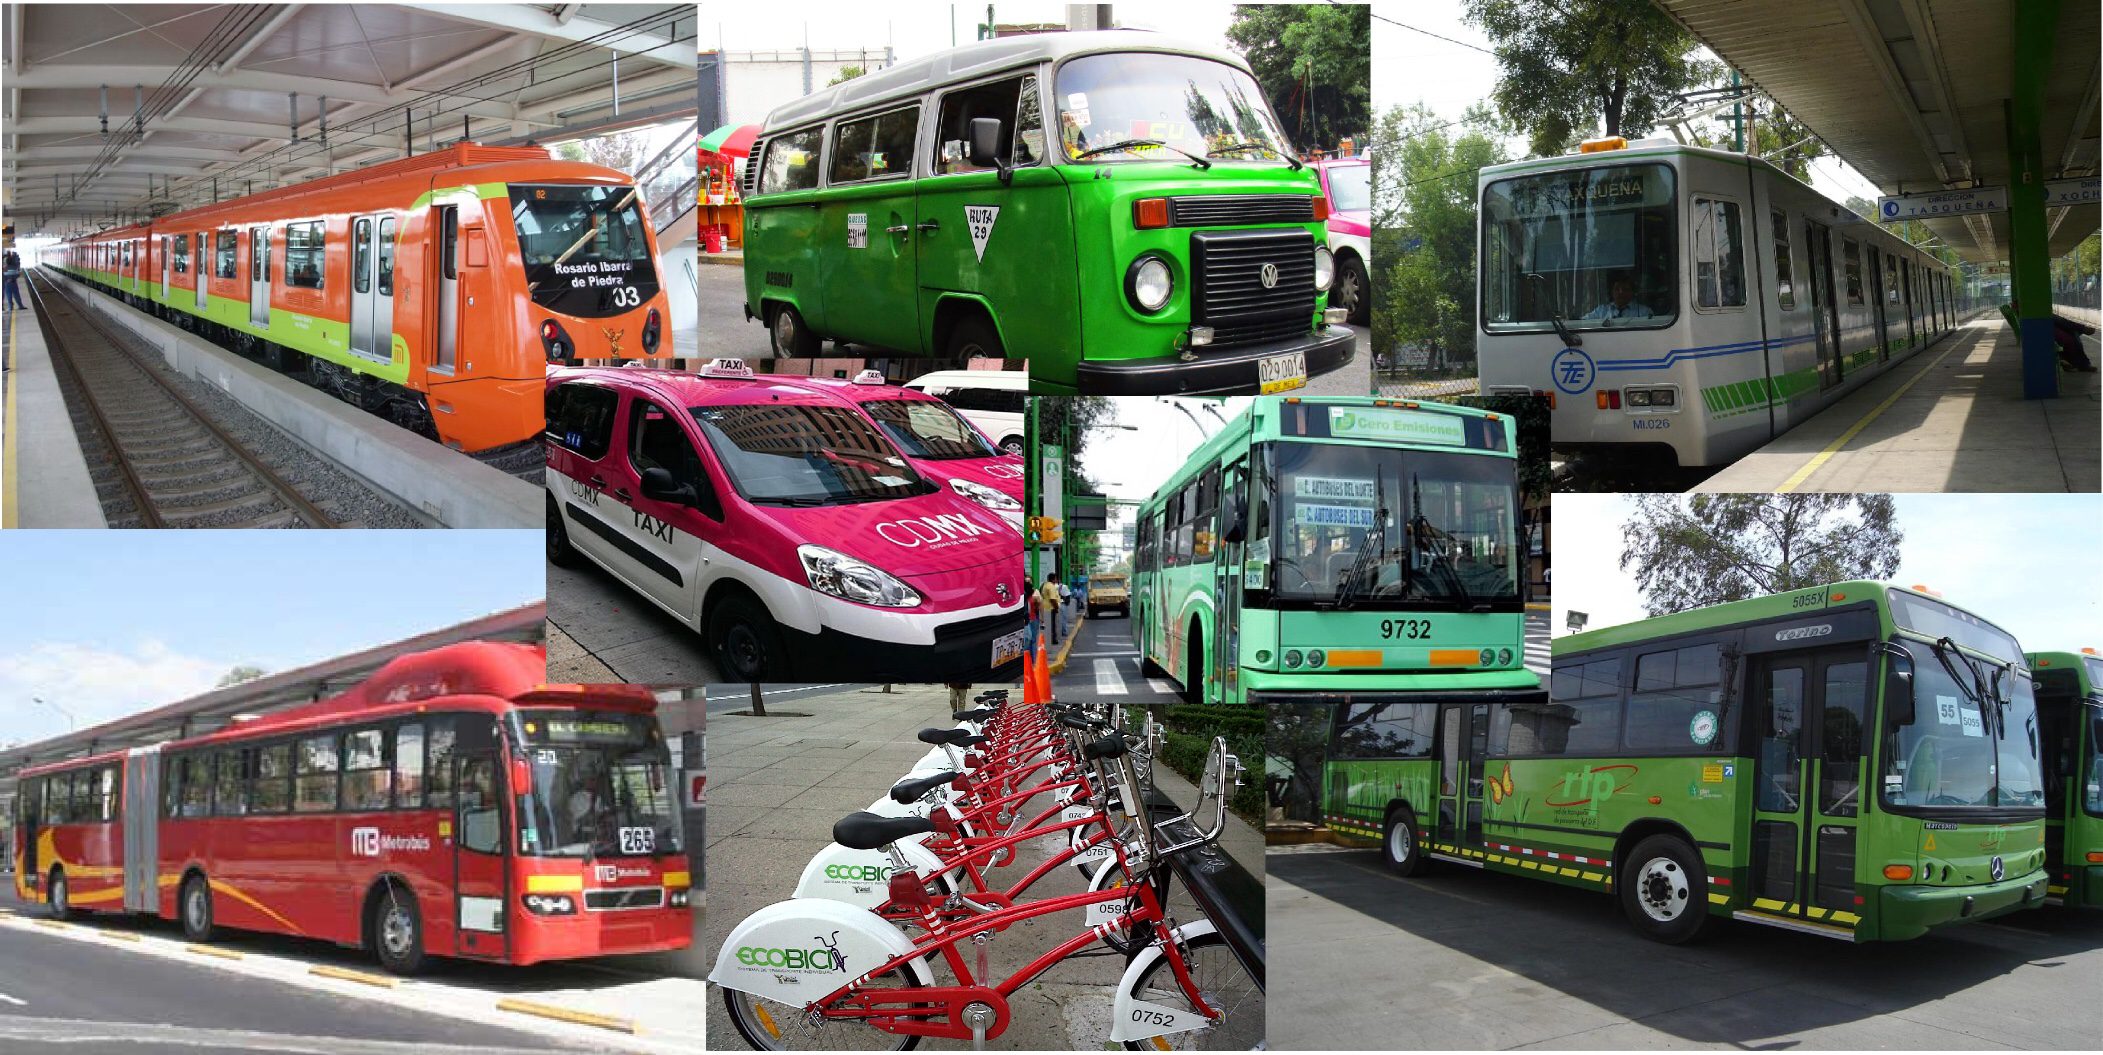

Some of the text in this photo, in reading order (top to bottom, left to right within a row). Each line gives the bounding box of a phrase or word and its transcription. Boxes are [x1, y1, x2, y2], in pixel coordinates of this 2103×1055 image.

[1565, 180, 1642, 200] AXQUEÑA
[969, 208, 993, 224] RUTA
[974, 225, 987, 239] 29
[555, 262, 597, 275] Rosario
[571, 277, 586, 288] de
[613, 286, 641, 307] 03
[720, 359, 743, 370] TAXI
[1358, 417, 1461, 436] Cero Emisiones
[571, 480, 599, 507] CDMX
[1344, 482, 1354, 496] DEL
[1355, 483, 1374, 498] NORTE
[1314, 507, 1347, 523] AUTOBUSES
[1349, 509, 1359, 524] DEL
[632, 507, 674, 544] TAXI
[876, 513, 994, 547] CDMX
[1792, 591, 1825, 608] 5055X
[1381, 619, 1431, 639] 9732
[1941, 704, 1955, 718] 55
[1963, 717, 1980, 728] 5055
[1563, 765, 1615, 816] rtp
[1086, 849, 1108, 857] 0751
[824, 864, 892, 881] ECOBIC
[736, 946, 833, 969] ECOBICI
[1131, 1009, 1175, 1028] 0752
